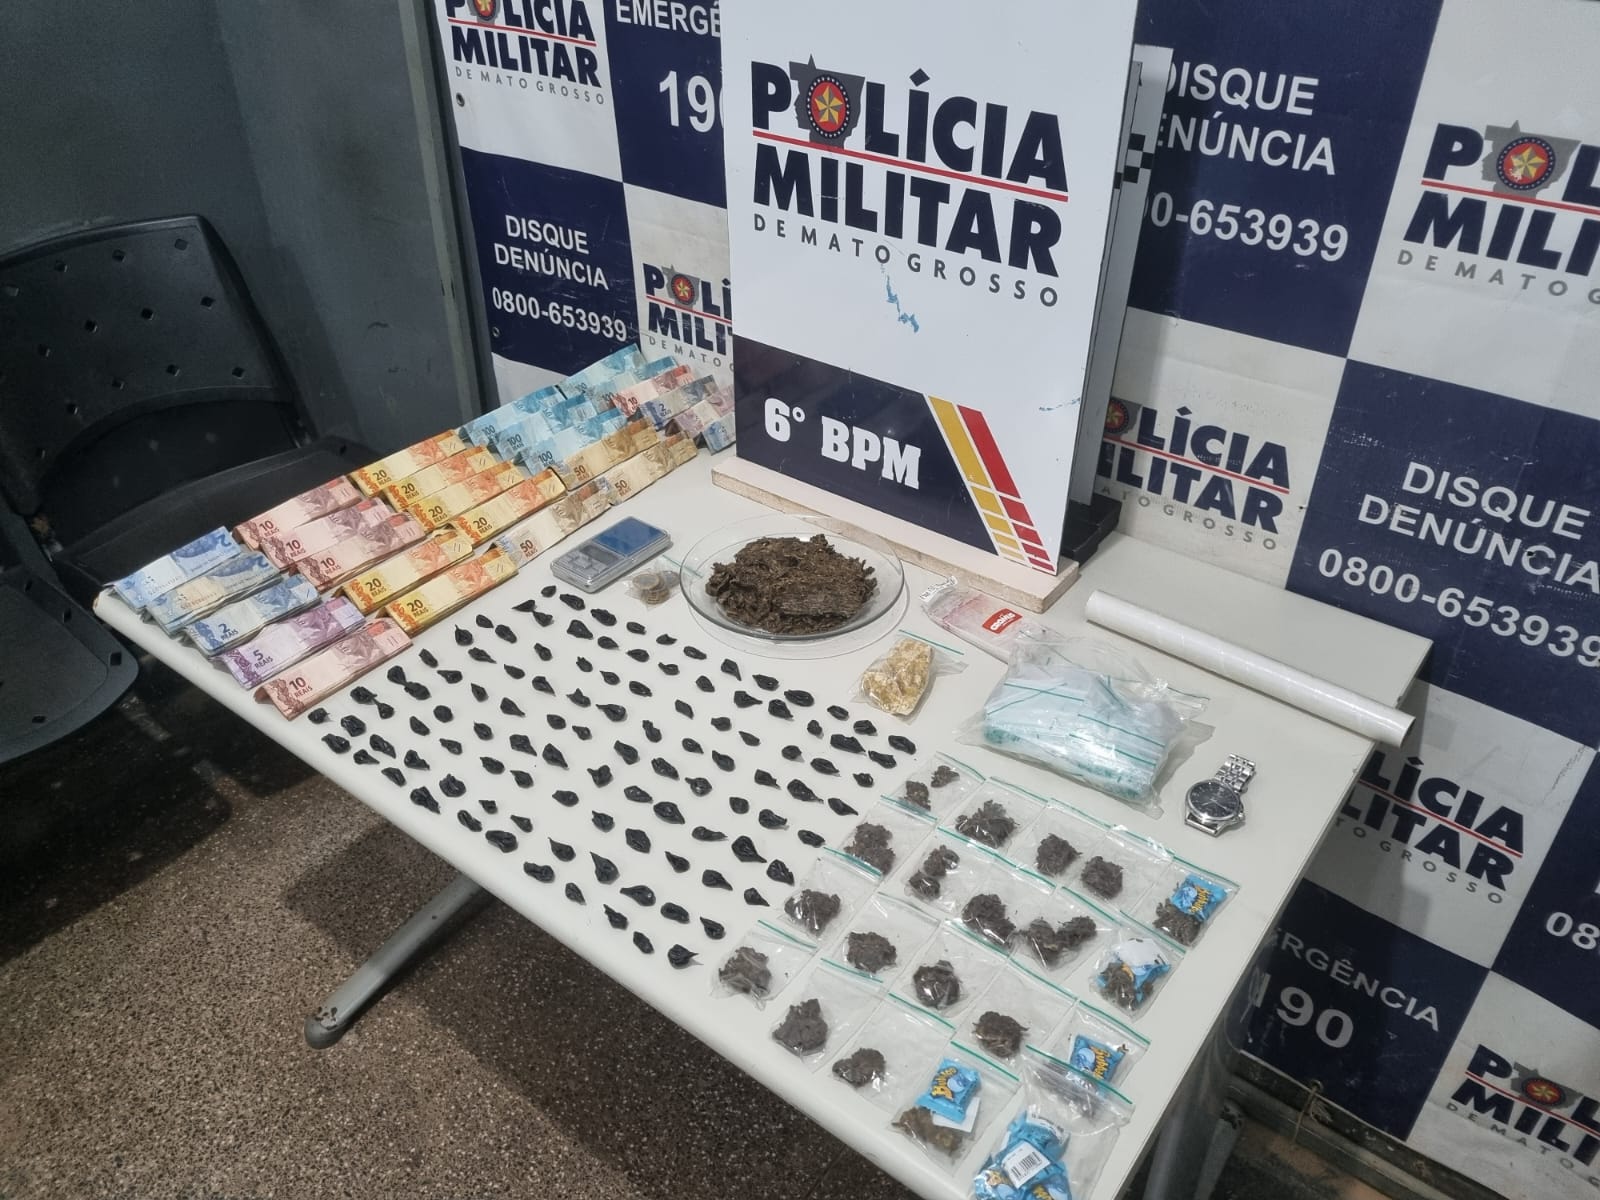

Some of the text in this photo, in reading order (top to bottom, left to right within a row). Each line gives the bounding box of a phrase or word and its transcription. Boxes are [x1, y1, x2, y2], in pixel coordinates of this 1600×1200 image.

[452, 25, 602, 88] MILITAR
[455, 66, 604, 105] DE MATO GROSSO
[658, 70, 724, 133] 19
[1157, 110, 1336, 176] NÚNCIA
[753, 142, 1059, 278] MILITAR
[1144, 191, 1349, 262] 0-653939
[504, 214, 590, 255] DISQUE
[494, 243, 609, 290] DENÚNCIA
[753, 213, 1058, 307] DE MATO GROSSO
[1397, 249, 1439, 272] DE
[1454, 261, 1568, 297] MATO
[492, 286, 627, 342] 0800-653939
[649, 337, 722, 367] DE MATO
[507, 434, 522, 446] 100
[538, 451, 553, 463] 100
[820, 415, 922, 490] BPM
[372, 469, 387, 481] 20
[402, 483, 415, 494] 20
[574, 465, 586, 476] 50
[614, 480, 628, 492] 50
[1097, 442, 1284, 535] ILITAR
[428, 505, 444, 518] 20
[1101, 486, 1277, 551] ATO GROSSO
[1402, 461, 1591, 540] DISQUE
[260, 520, 274, 532] 10
[473, 516, 488, 530] 20
[286, 540, 301, 552] 10
[520, 540, 534, 553] 50
[1358, 493, 1600, 595] DENÚNCIA
[320, 558, 336, 570] 10
[365, 578, 382, 592] 20
[406, 599, 424, 613] 20
[1318, 548, 1600, 668] 0800-653939
[218, 622, 231, 634] 2
[252, 650, 264, 662] 5
[254, 656, 274, 669] REAIS
[289, 676, 306, 690] 10
[1360, 750, 1524, 854] LÍCIA
[1341, 787, 1515, 892] LITAR
[1379, 841, 1503, 904] GROSSO
[1277, 929, 1439, 1032] RGÊNCIA
[1446, 1102, 1478, 1122] DE
